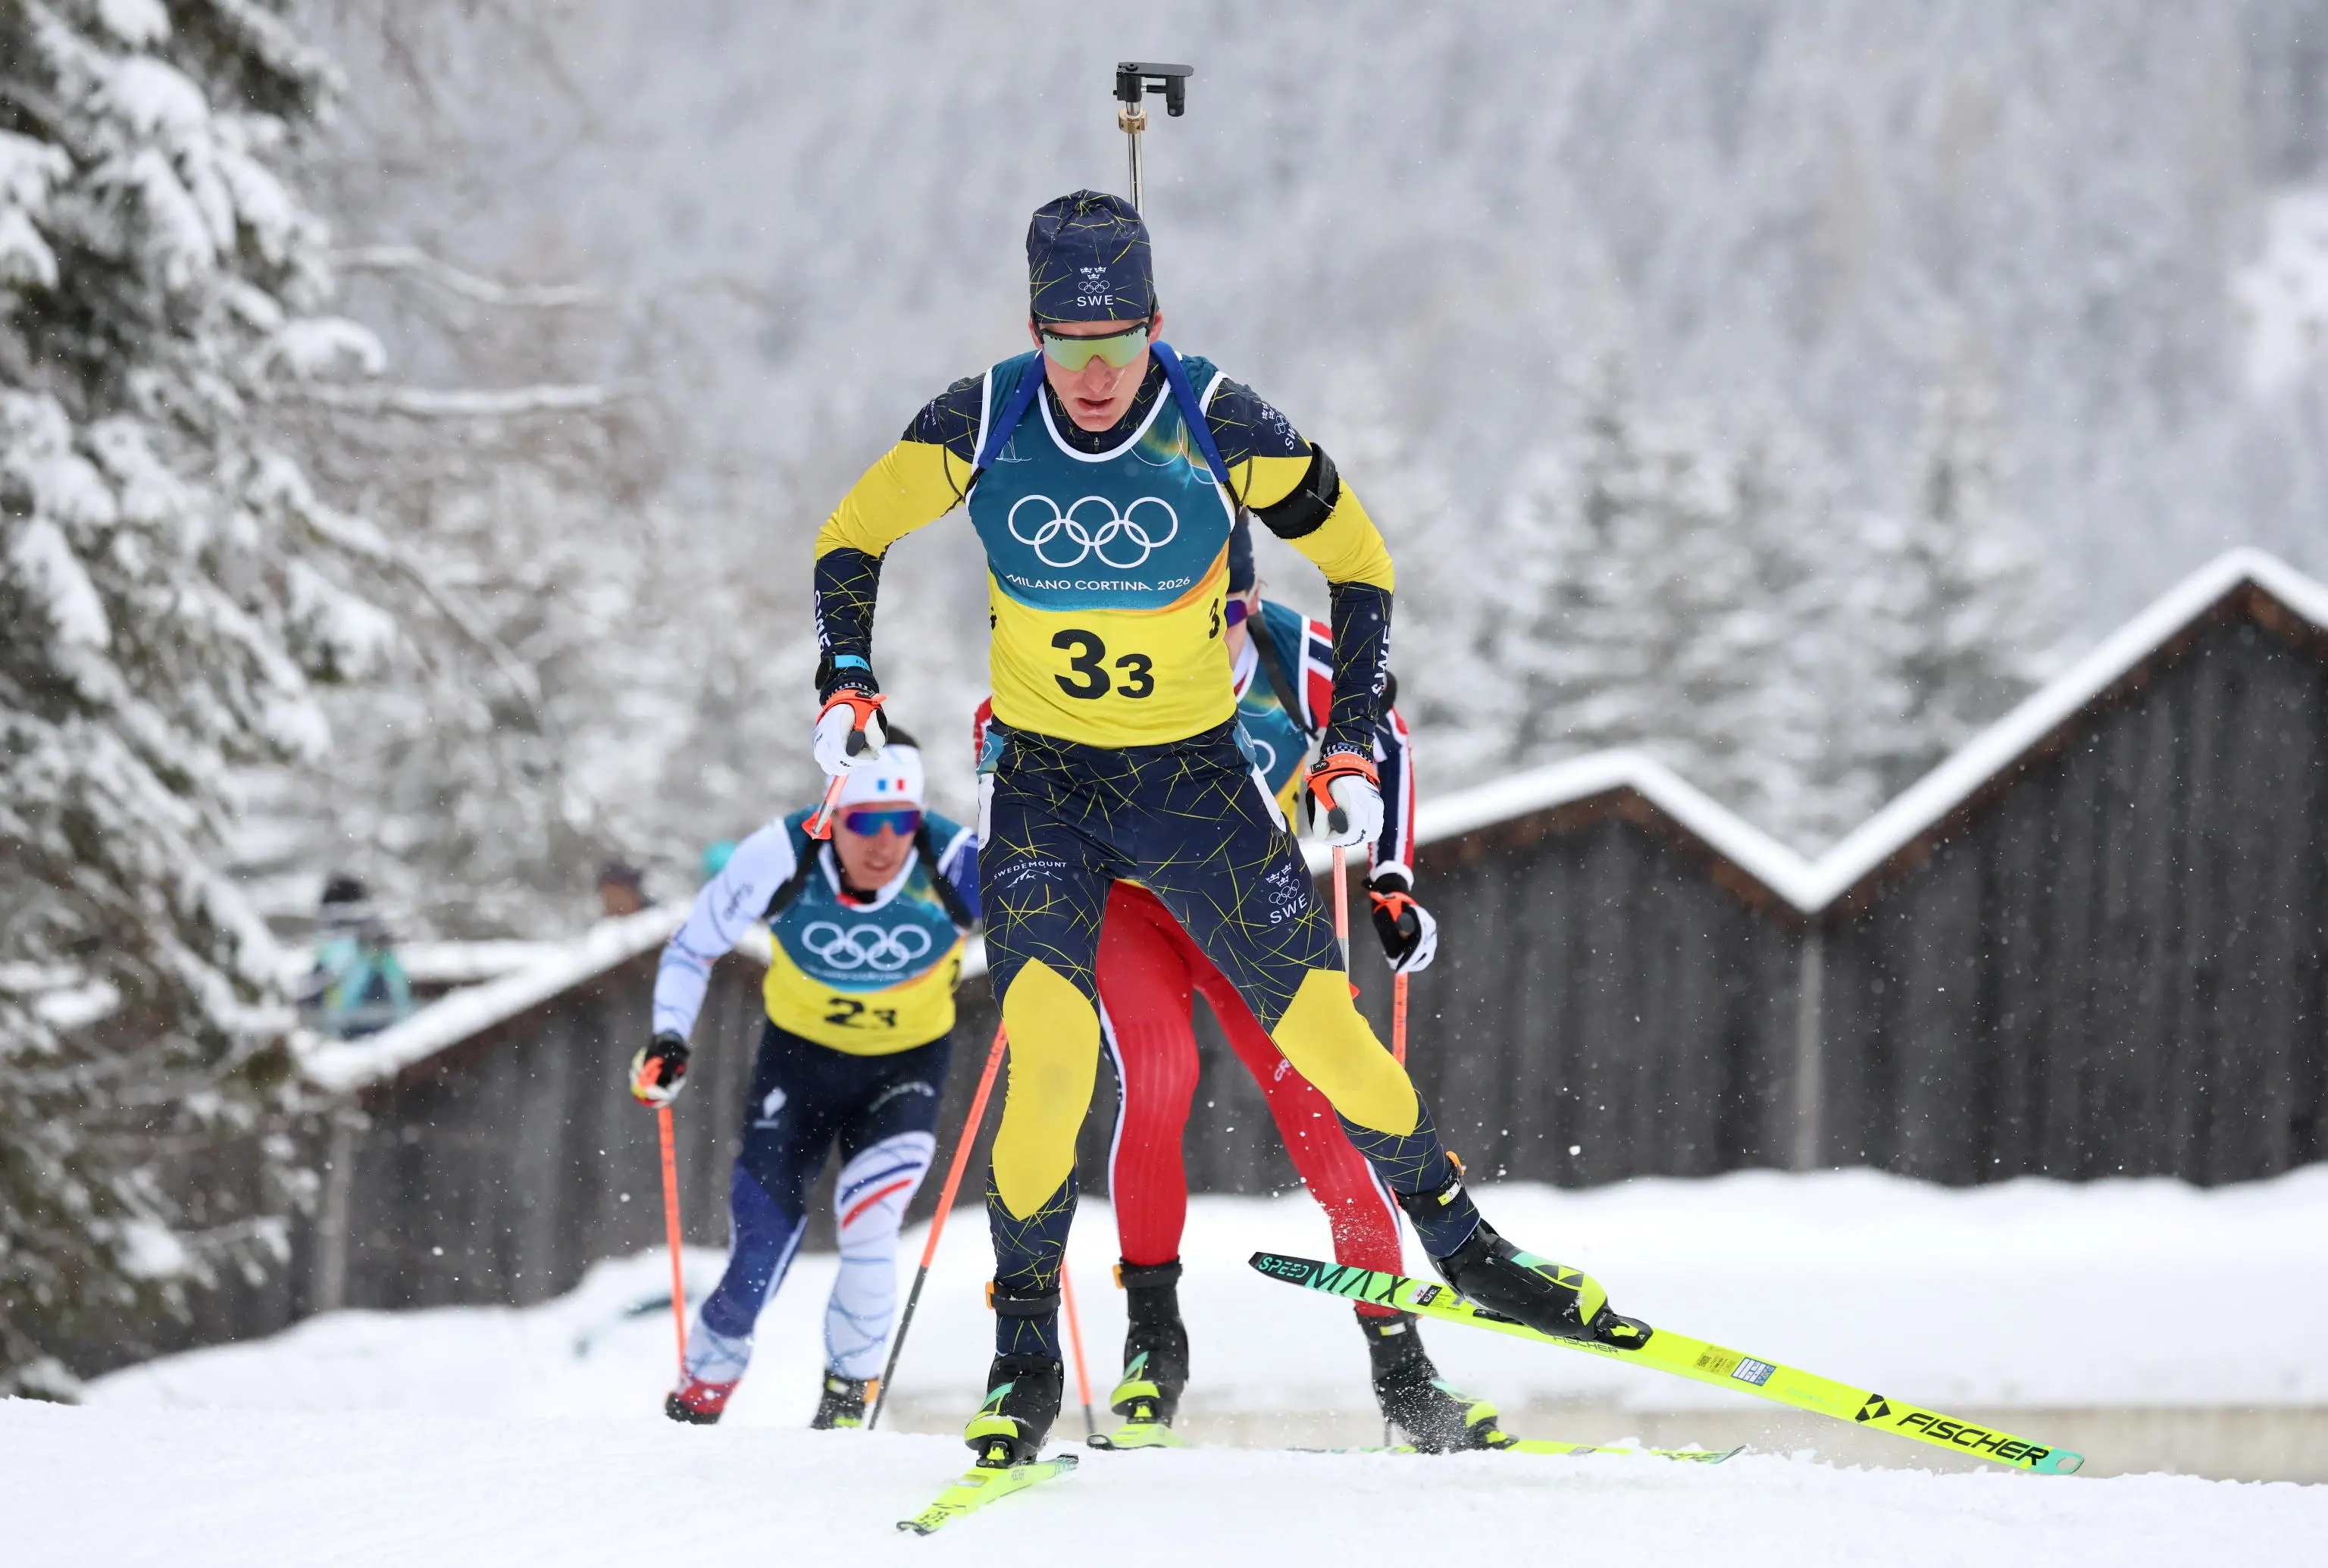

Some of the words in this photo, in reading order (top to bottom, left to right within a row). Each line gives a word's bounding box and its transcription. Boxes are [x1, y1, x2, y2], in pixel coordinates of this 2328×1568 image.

[1077, 295, 1114, 307] SWE
[1284, 424, 1296, 450] SW
[1006, 574, 1071, 590] MILANO
[1075, 580, 1153, 591] CORTINA
[1157, 577, 1191, 590] 2026
[993, 861, 1067, 880] SWEDEMOUNT
[1270, 893, 1308, 924] SWE
[1897, 1413, 2049, 1466] FISCHER
